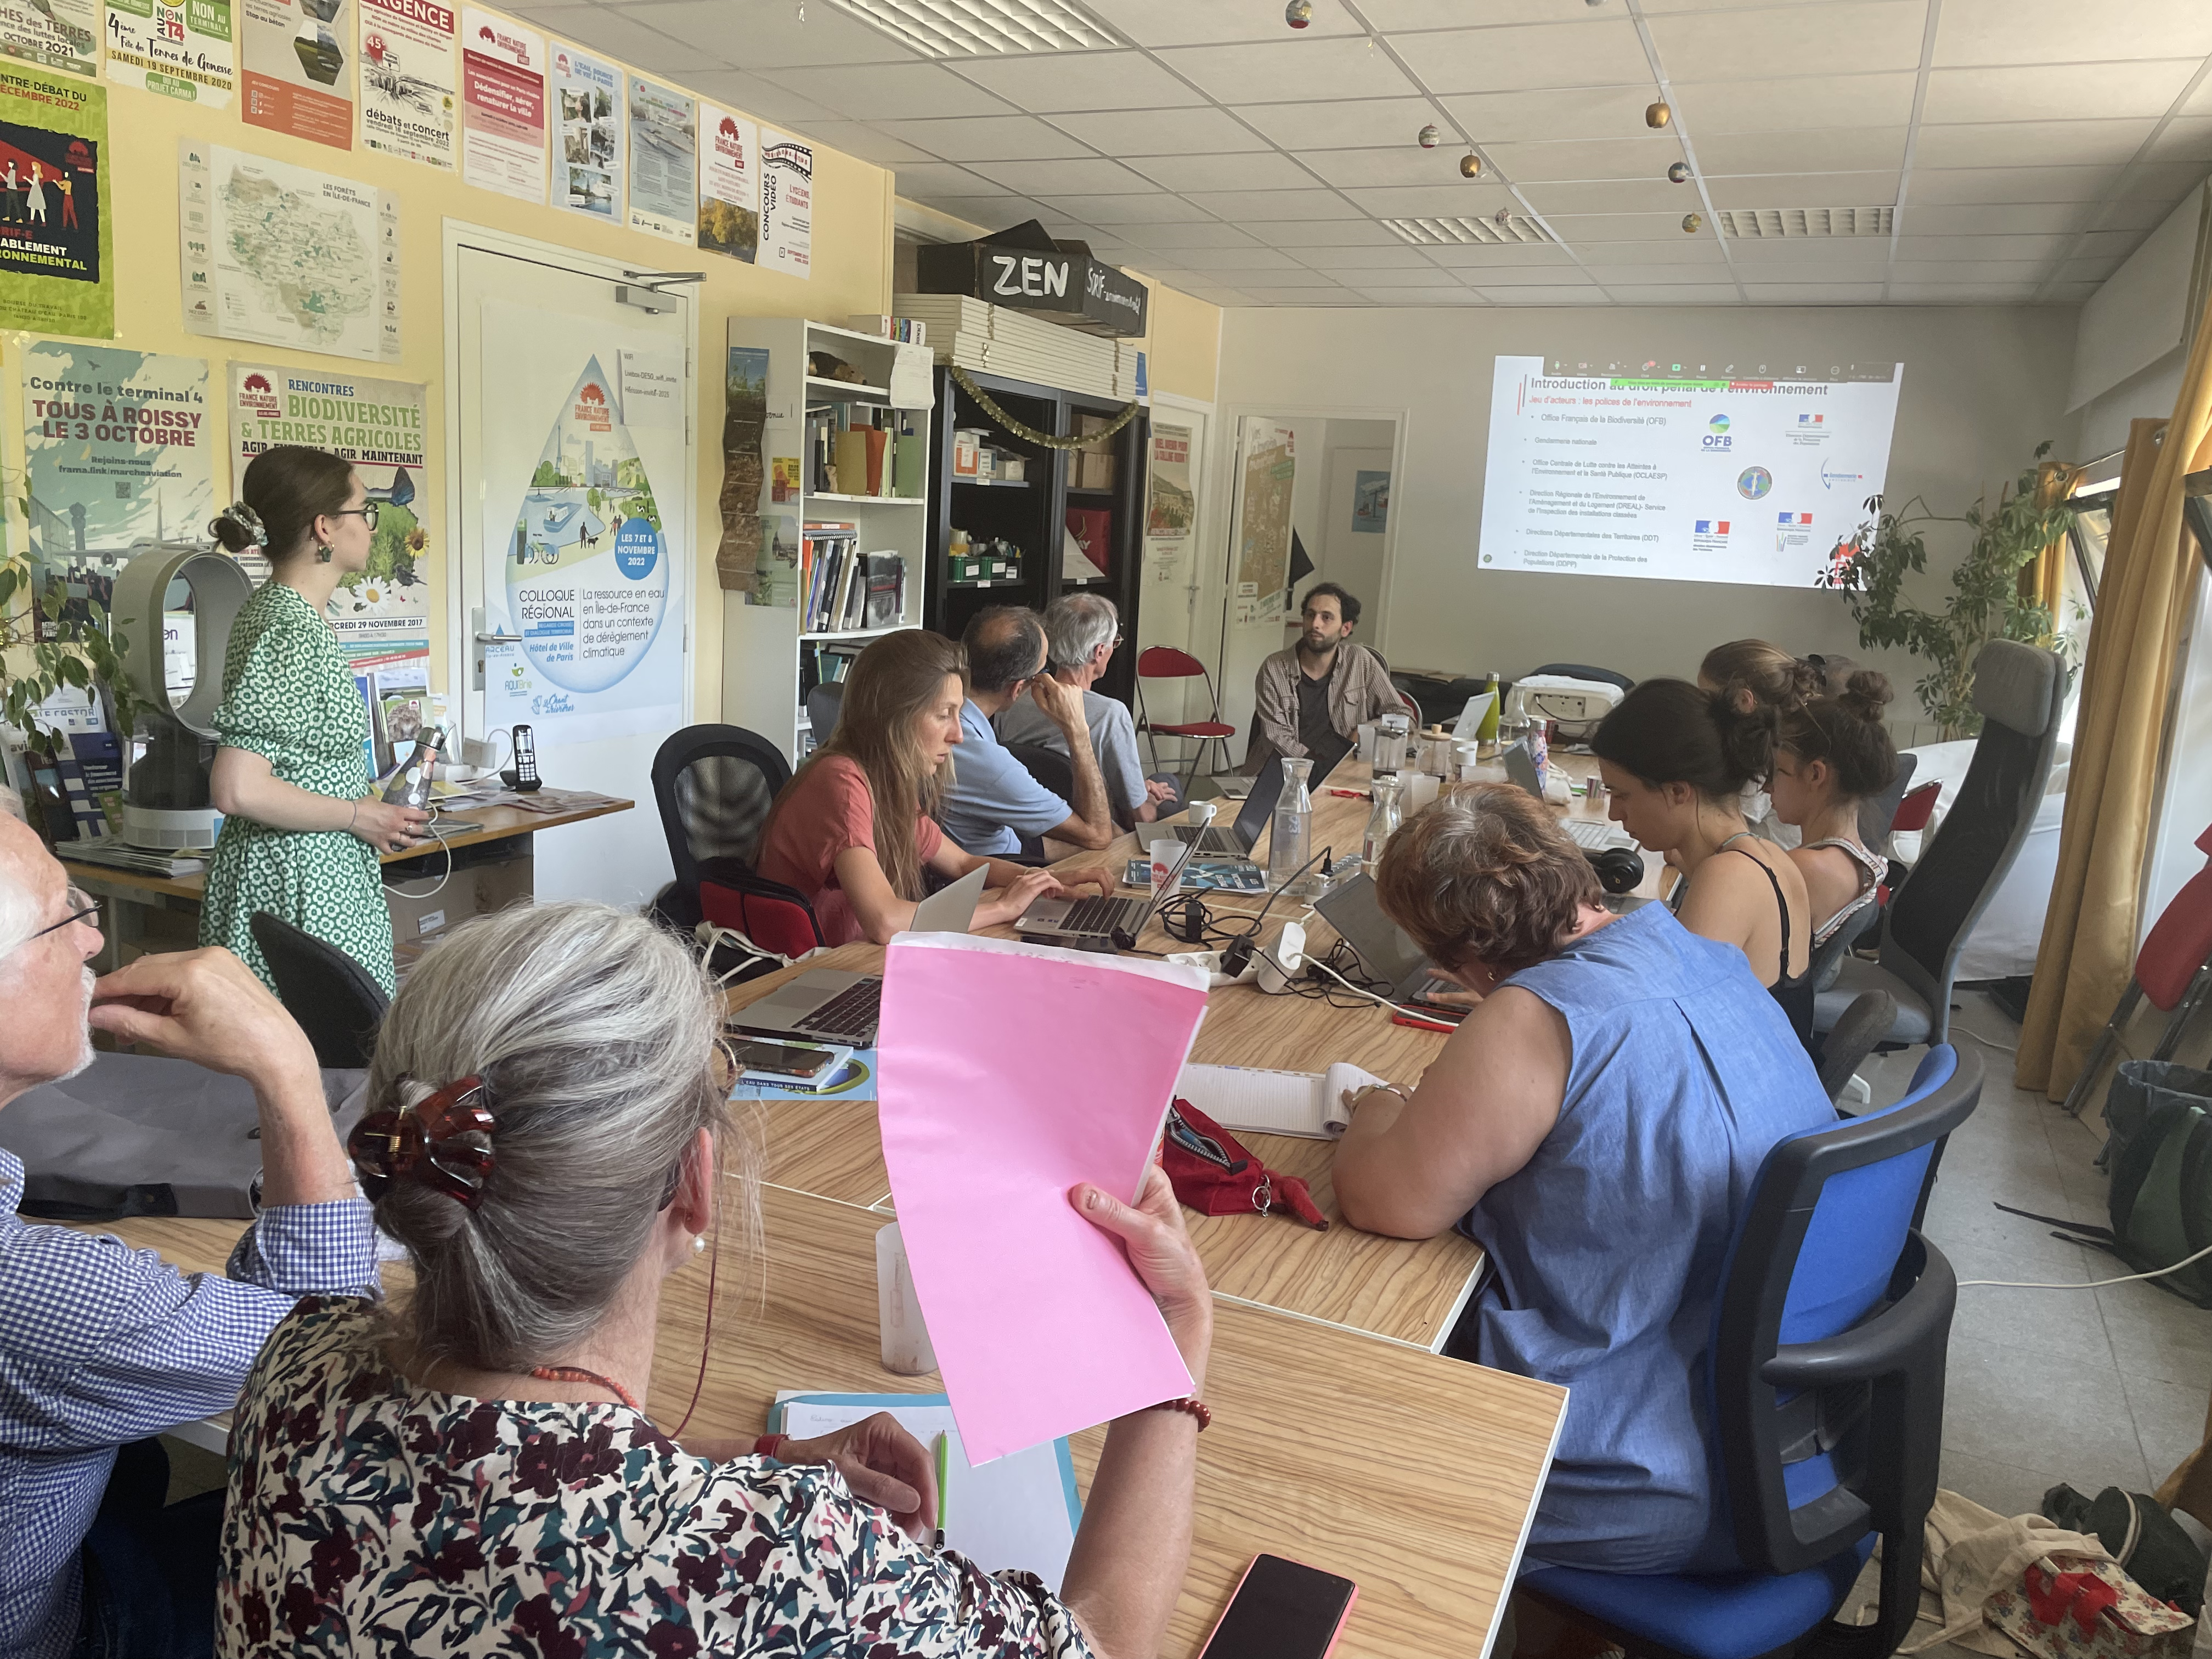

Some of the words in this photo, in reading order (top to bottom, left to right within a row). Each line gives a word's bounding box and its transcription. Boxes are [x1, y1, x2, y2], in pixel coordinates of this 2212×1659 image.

[193, 1, 215, 21] NON
[218, 15, 225, 24] AU
[246, 10, 259, 20] Stop
[371, 0, 449, 29] GENCE
[26, 17, 42, 28] des
[45, 19, 91, 42] TERRES
[166, 20, 184, 41] T4
[190, 16, 222, 32] TERMINAL
[18, 25, 31, 34] des
[33, 28, 55, 40] luttes
[58, 35, 85, 48] locales
[497, 33, 511, 44] FRANCE
[4, 32, 43, 49] OCTOBRE
[46, 41, 74, 57] 2021
[146, 37, 178, 61] Terres
[182, 51, 194, 66] de
[198, 53, 233, 76] Gonesse
[112, 50, 143, 66] SAMEDI
[148, 61, 156, 70] 19
[160, 64, 208, 84] SEPTEMBRE
[212, 78, 232, 90] 2020
[575, 61, 591, 73] L'EAU,
[1, 75, 69, 98] NTRE-DÉBAT
[72, 91, 87, 101] DU
[147, 80, 170, 93] PROJET
[171, 87, 191, 98] CARMA
[475, 81, 514, 103] Dédensifier,
[516, 96, 534, 110] aérer,
[55, 98, 80, 111] 2022
[477, 94, 509, 109] renaturer
[510, 103, 516, 112] la
[518, 107, 532, 117] ville
[366, 108, 402, 127] débats
[413, 123, 449, 141] concert
[366, 119, 393, 130] vendredi
[403, 129, 433, 143] septembre
[436, 138, 449, 147] 2022
[715, 136, 729, 148] FRANCE
[334, 184, 356, 196] FORÊTS
[786, 194, 808, 209] ÉTUDIANTS
[1, 238, 67, 256] ABLEMENT
[0, 250, 87, 270] ONNEMENTAL
[992, 255, 1069, 297] ZEN
[30, 376, 92, 393] Contre
[97, 382, 113, 396] le
[117, 386, 189, 402] terminal
[193, 392, 202, 403] 4
[288, 379, 354, 397] RENCONTRES
[1531, 377, 1605, 390] Introduction
[239, 393, 258, 401] FRANCE
[1544, 396, 1576, 404] d'acteurs
[1583, 397, 1593, 405] les
[1595, 398, 1620, 407] polices
[1633, 398, 1691, 408] l'environnement
[240, 400, 277, 409] ENVIRONNEMENT
[288, 394, 421, 429] BIODIVERSITÉ
[575, 404, 592, 413] FRANCE
[594, 407, 609, 415] NATURE
[32, 399, 96, 421] TOUS
[101, 399, 118, 422] À
[123, 407, 202, 428] ROISSY
[1561, 414, 1588, 424] Français
[1607, 416, 1644, 424] Biodiversité
[1646, 417, 1667, 426] (OFB)
[43, 420, 69, 439] LE
[75, 422, 89, 440] 3
[95, 424, 195, 447] OCTOBRE
[241, 421, 252, 438] &
[257, 420, 327, 444] TERRES
[331, 426, 421, 451] AGRICOLES
[1702, 435, 1733, 447] OFB
[92, 456, 151, 466] Rejoins-nous
[334, 448, 357, 460] AGIR
[362, 450, 423, 465] MAINTENANT
[622, 534, 633, 543] LES
[1554, 529, 1600, 538] Départementales
[1641, 534, 1659, 543] (DDT)
[617, 545, 655, 555] NOVEMBRE
[1549, 551, 1592, 560] Départementale
[1608, 554, 1636, 562] Protection
[628, 557, 645, 566] 2022
[1523, 558, 1554, 566] Populations
[520, 589, 575, 602] COLLOQUE
[583, 589, 593, 599] La
[594, 590, 633, 599] ressource
[635, 590, 646, 599] en
[648, 590, 664, 599] eau
[522, 603, 574, 619] RÉGIONAL
[583, 606, 594, 614] en
[595, 601, 650, 613] Île-de-France
[583, 618, 603, 629] dans
[605, 619, 614, 628] un
[617, 618, 653, 628] contexte
[583, 633, 594, 643] de
[596, 630, 648, 644] dérèglement
[530, 644, 548, 652] Hôtel
[559, 642, 573, 650] Ville
[583, 646, 625, 659] climatique
[556, 653, 573, 661] Paris
[549, 693, 568, 704] Chant
